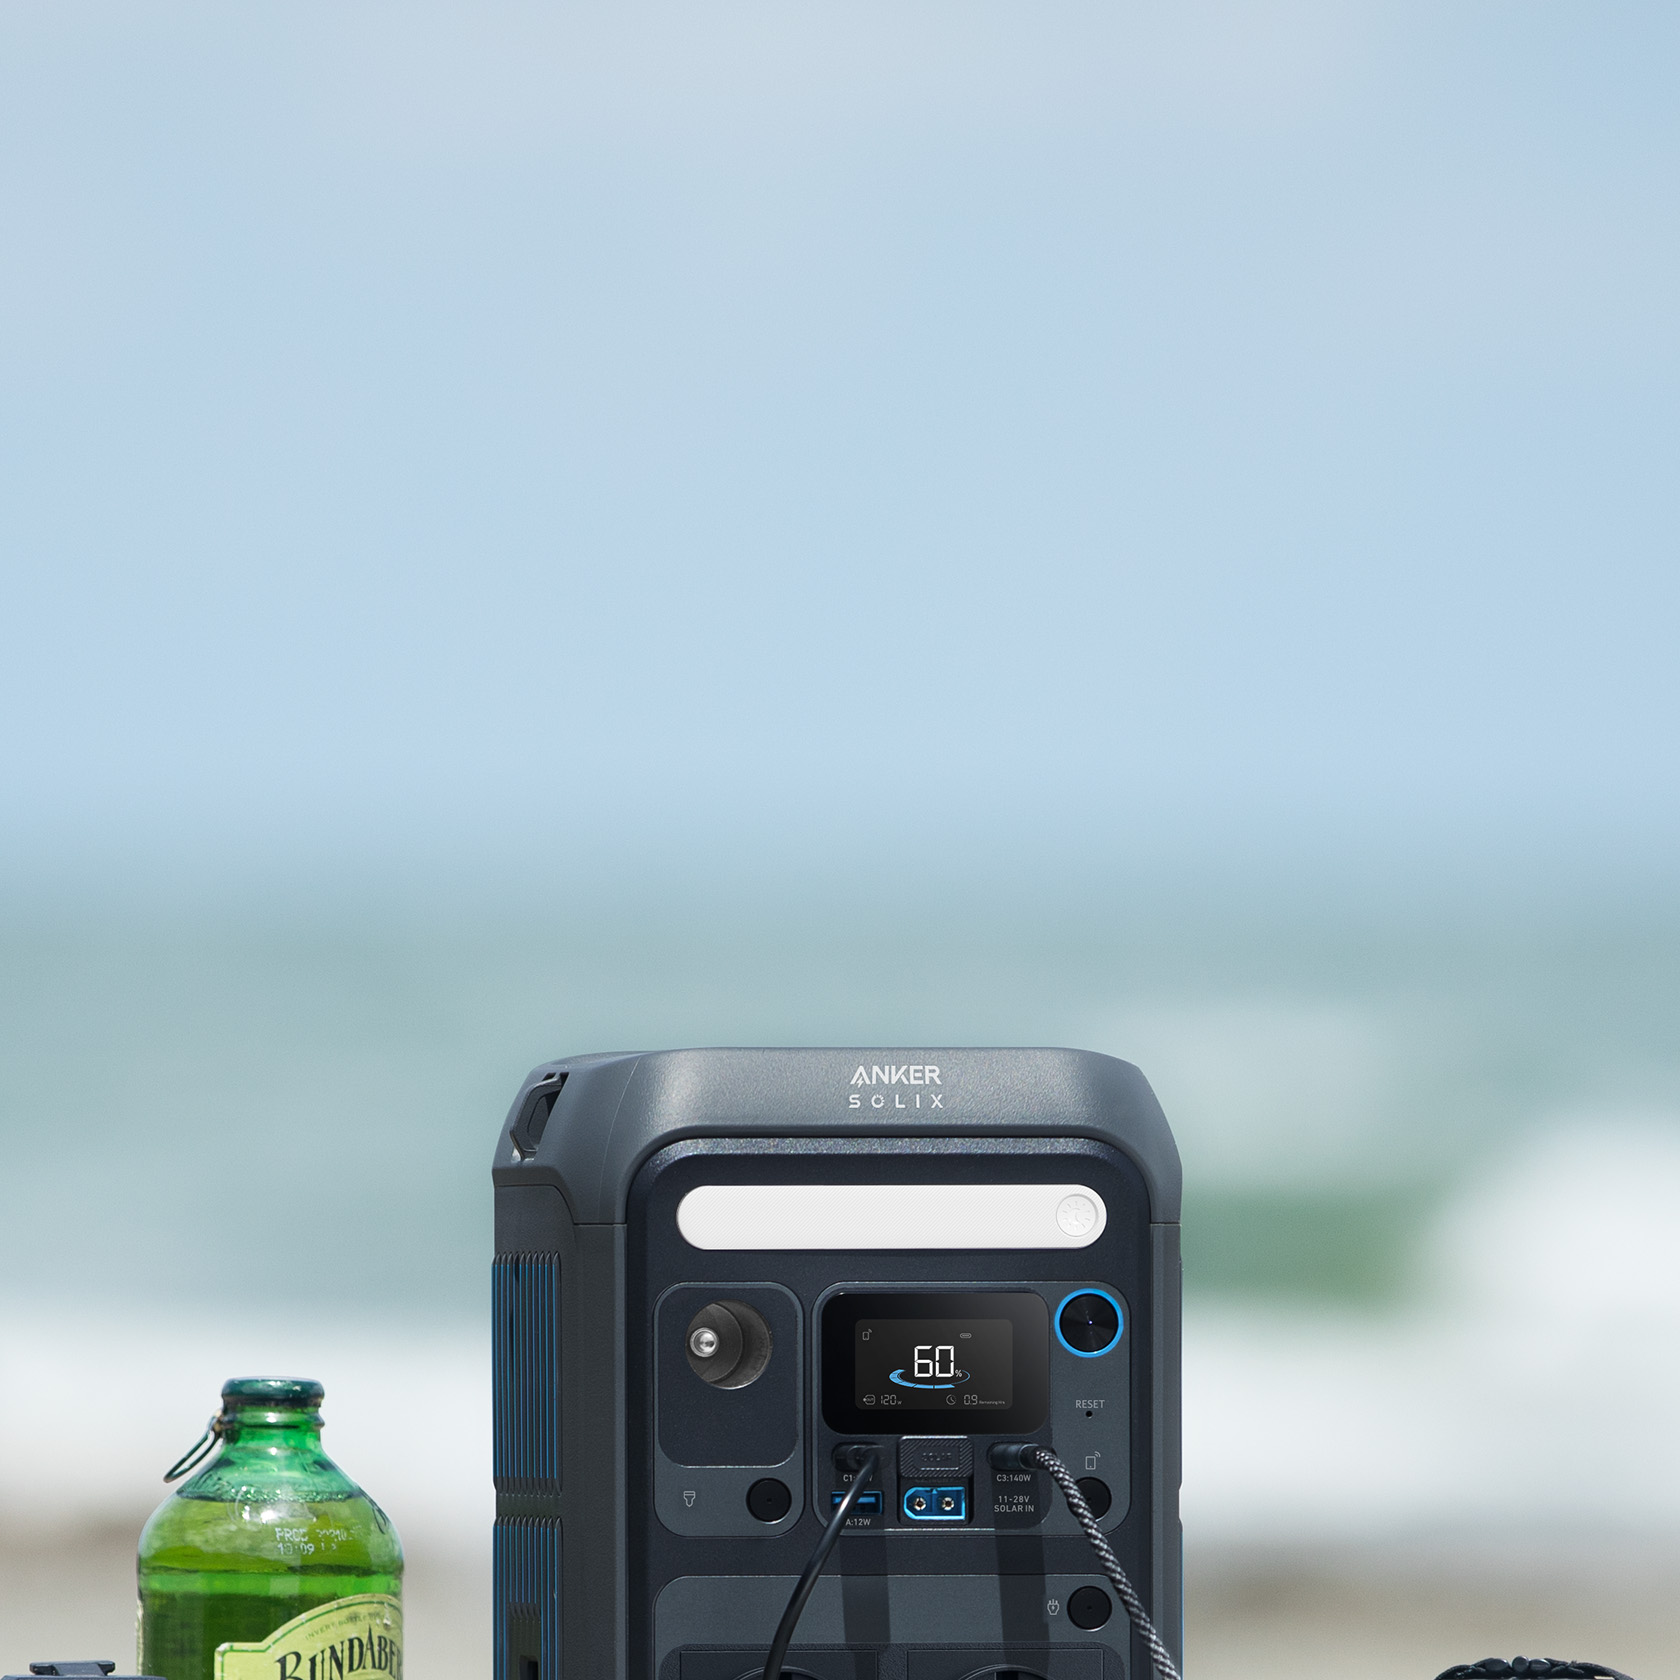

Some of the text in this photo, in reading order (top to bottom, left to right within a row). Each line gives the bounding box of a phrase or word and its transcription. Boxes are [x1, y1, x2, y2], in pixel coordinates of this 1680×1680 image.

[849, 1065, 942, 1088] ANKER
[848, 1094, 944, 1109] SOLIX
[1075, 1399, 1106, 1409] RESET
[996, 1473, 1031, 1483] C3:140W
[998, 1495, 1030, 1504] 11-28V
[994, 1504, 1034, 1513] SOLAR IN
[845, 1518, 871, 1527] A:12W
